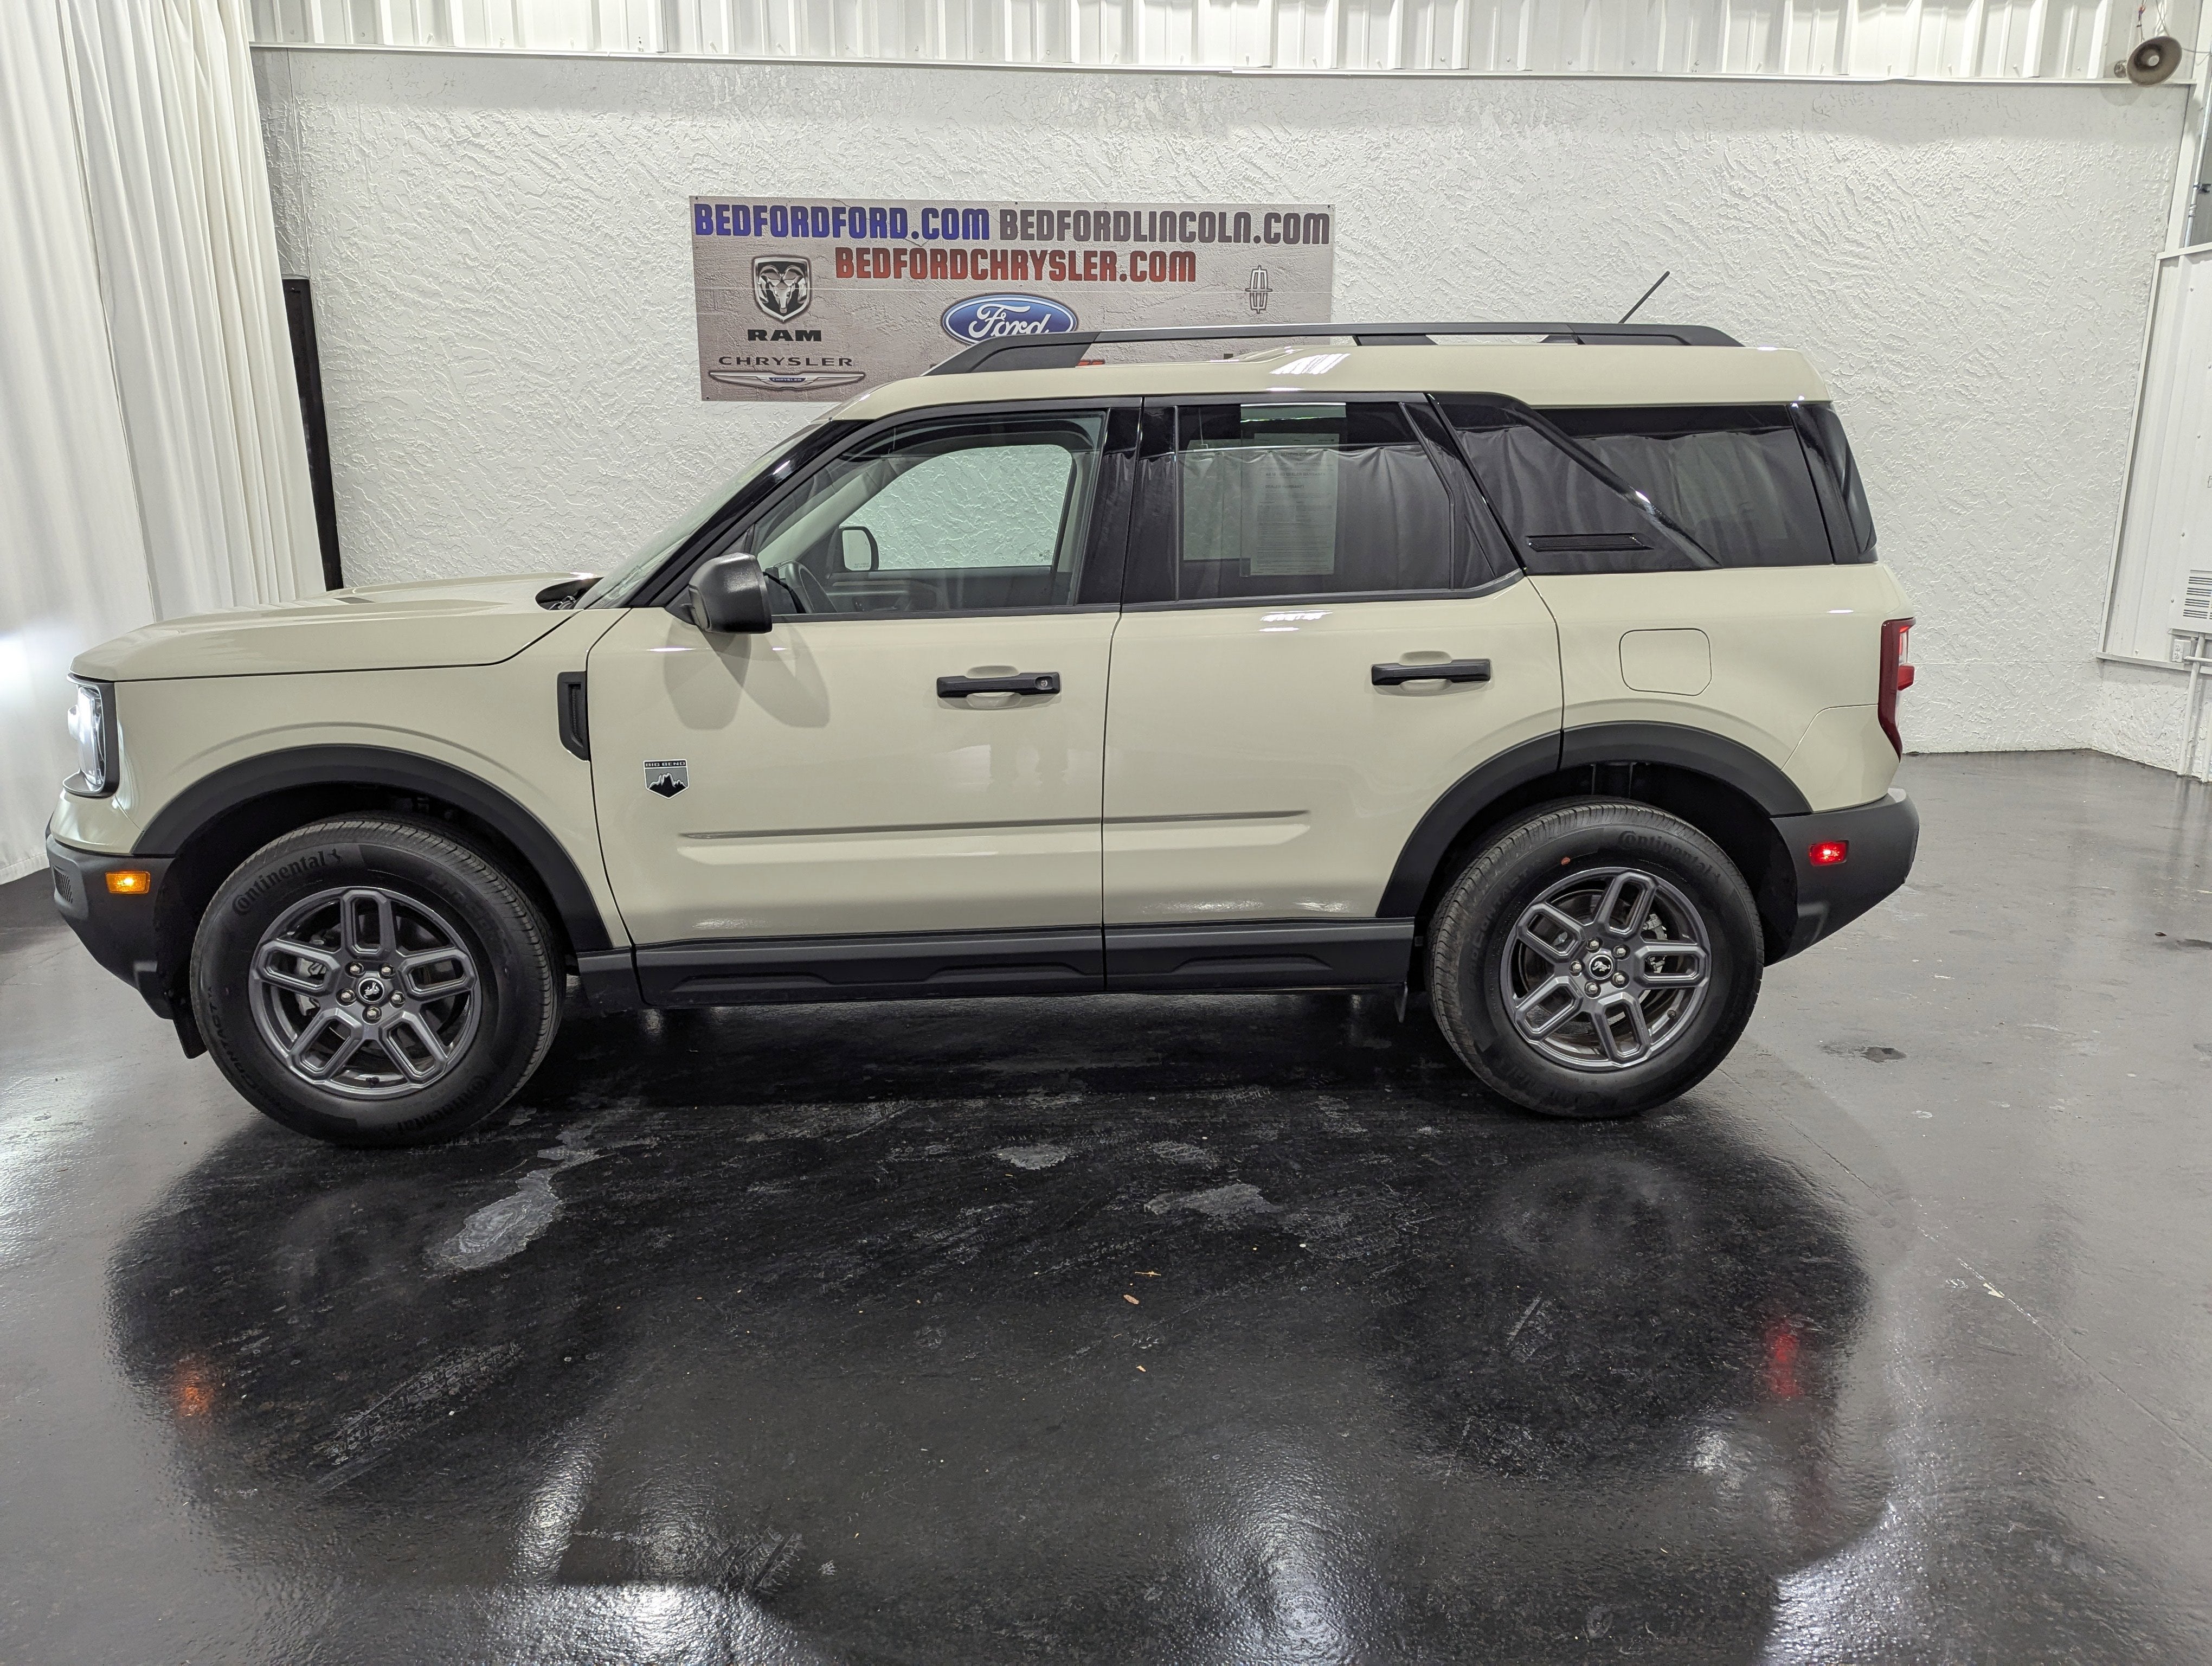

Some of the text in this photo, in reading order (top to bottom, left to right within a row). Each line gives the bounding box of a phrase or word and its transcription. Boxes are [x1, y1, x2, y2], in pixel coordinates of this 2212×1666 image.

[694, 203, 1330, 245] BEDFORDFORD.COM BEDFORDLINCOLN.COM
[835, 247, 1196, 282] BEDFORDCHRYSLER.COM
[747, 329, 822, 342] RAM
[968, 303, 1050, 338] Ford
[718, 356, 853, 367] CHRYSLER
[1617, 830, 1713, 874] Continental
[232, 850, 326, 916] Continental
